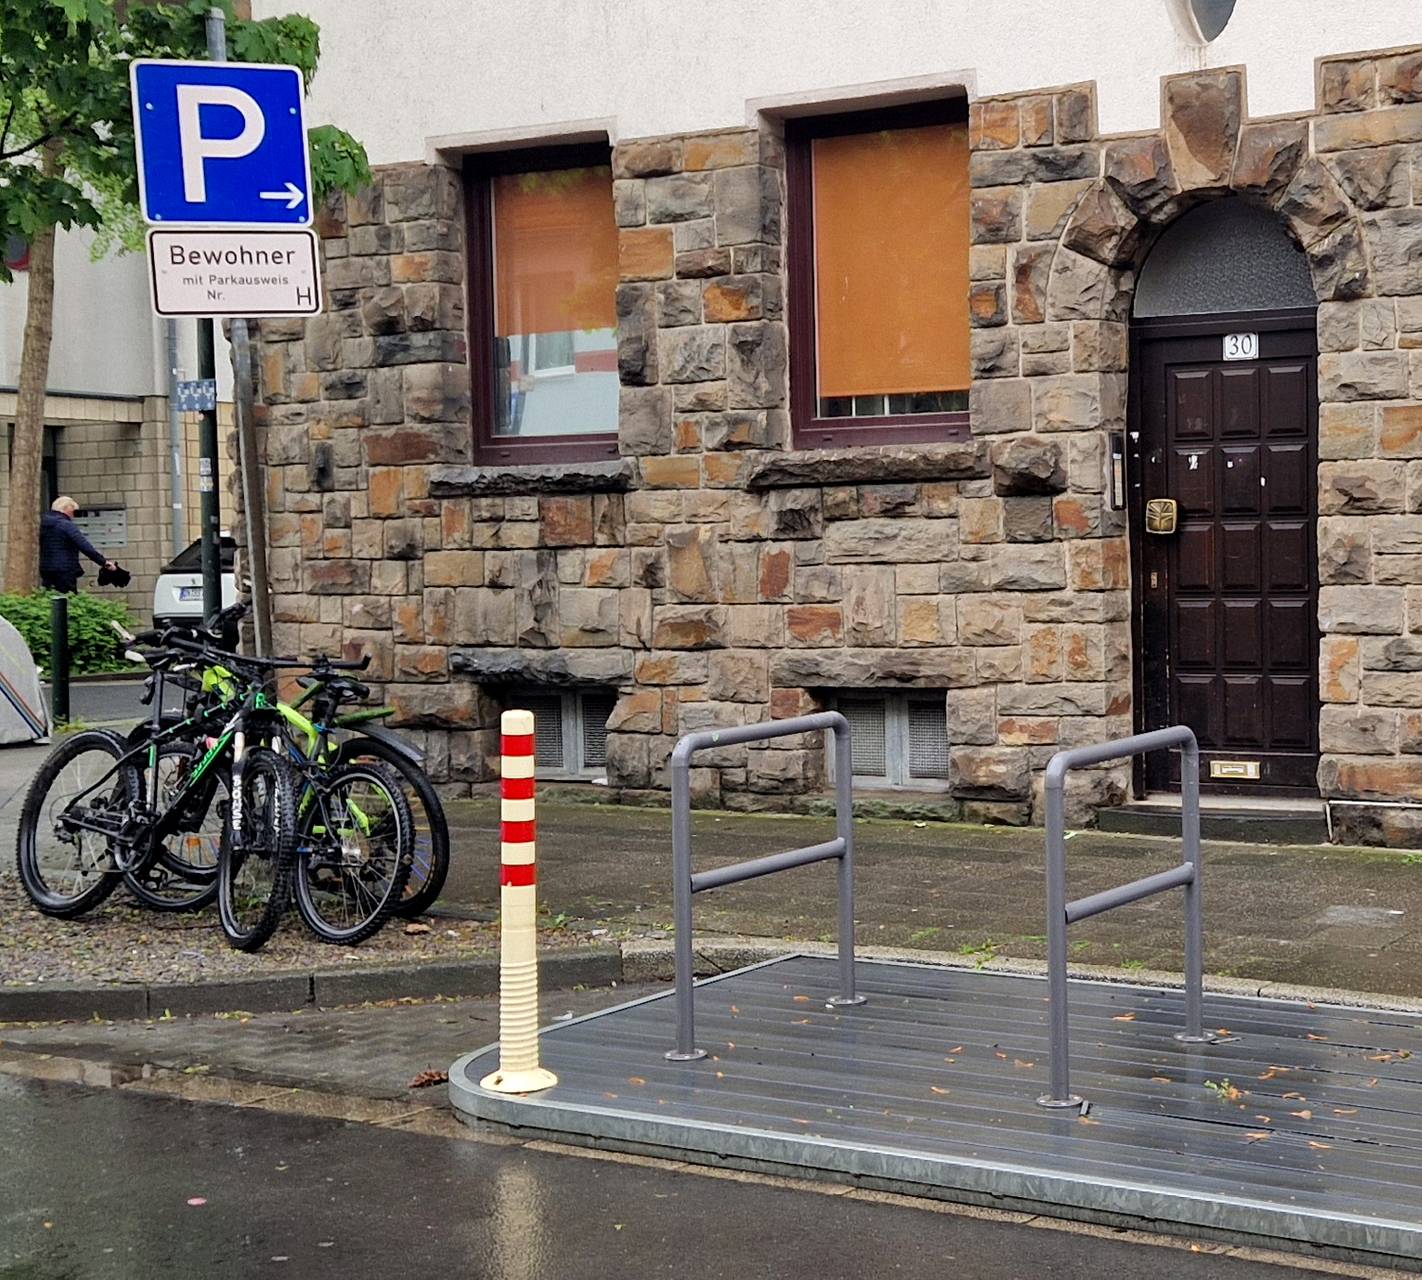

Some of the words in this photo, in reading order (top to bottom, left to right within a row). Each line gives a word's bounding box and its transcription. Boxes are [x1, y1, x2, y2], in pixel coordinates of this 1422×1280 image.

[176, 84, 265, 202] P
[170, 245, 295, 265] Bewohner
[183, 275, 204, 285] mit
[209, 274, 289, 285] Parkausweis
[207, 290, 226, 301] Nr.
[296, 286, 312, 306] H
[1229, 335, 1252, 355] 30
